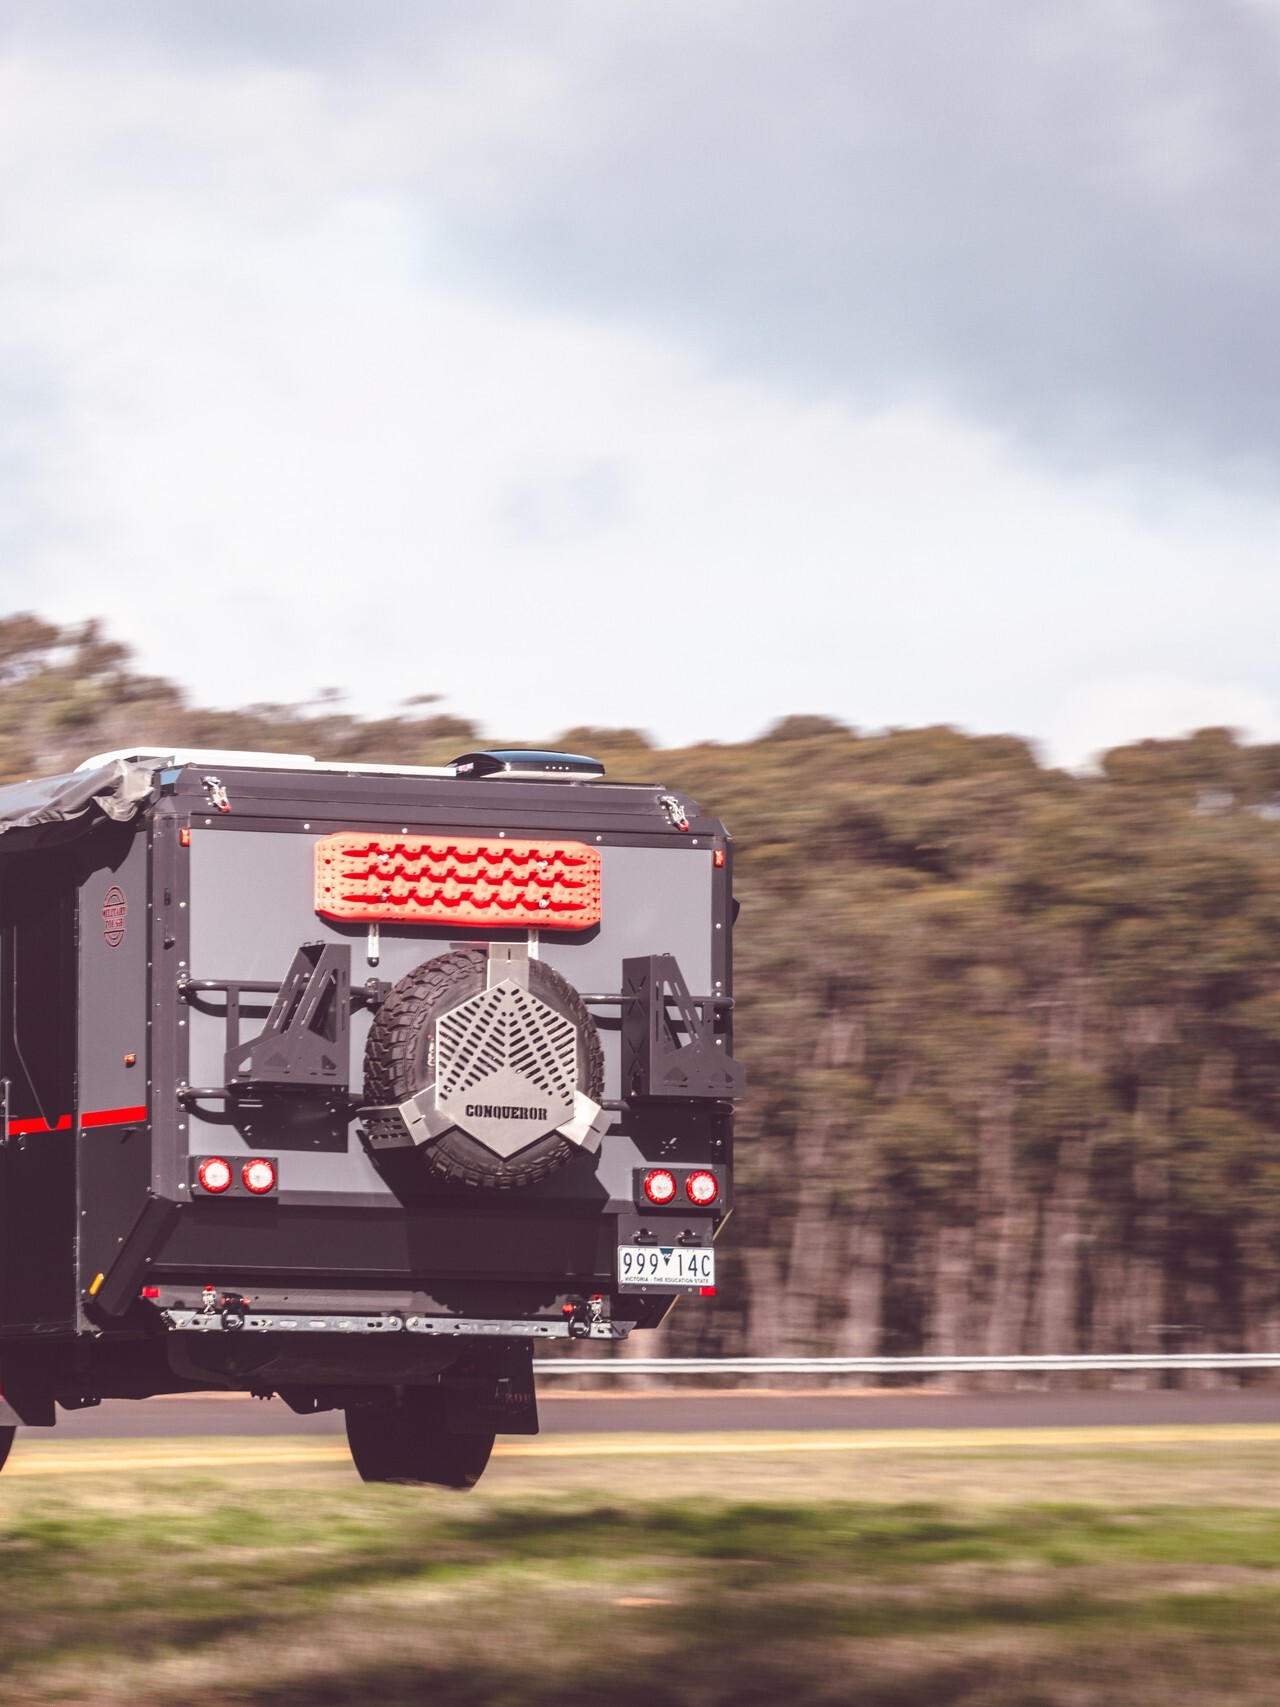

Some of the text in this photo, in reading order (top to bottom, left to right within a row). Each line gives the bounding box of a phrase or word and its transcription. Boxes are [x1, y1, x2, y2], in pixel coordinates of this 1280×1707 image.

[465, 1104, 548, 1121] CONQUEROR
[623, 1252, 711, 1277] 999 14C
